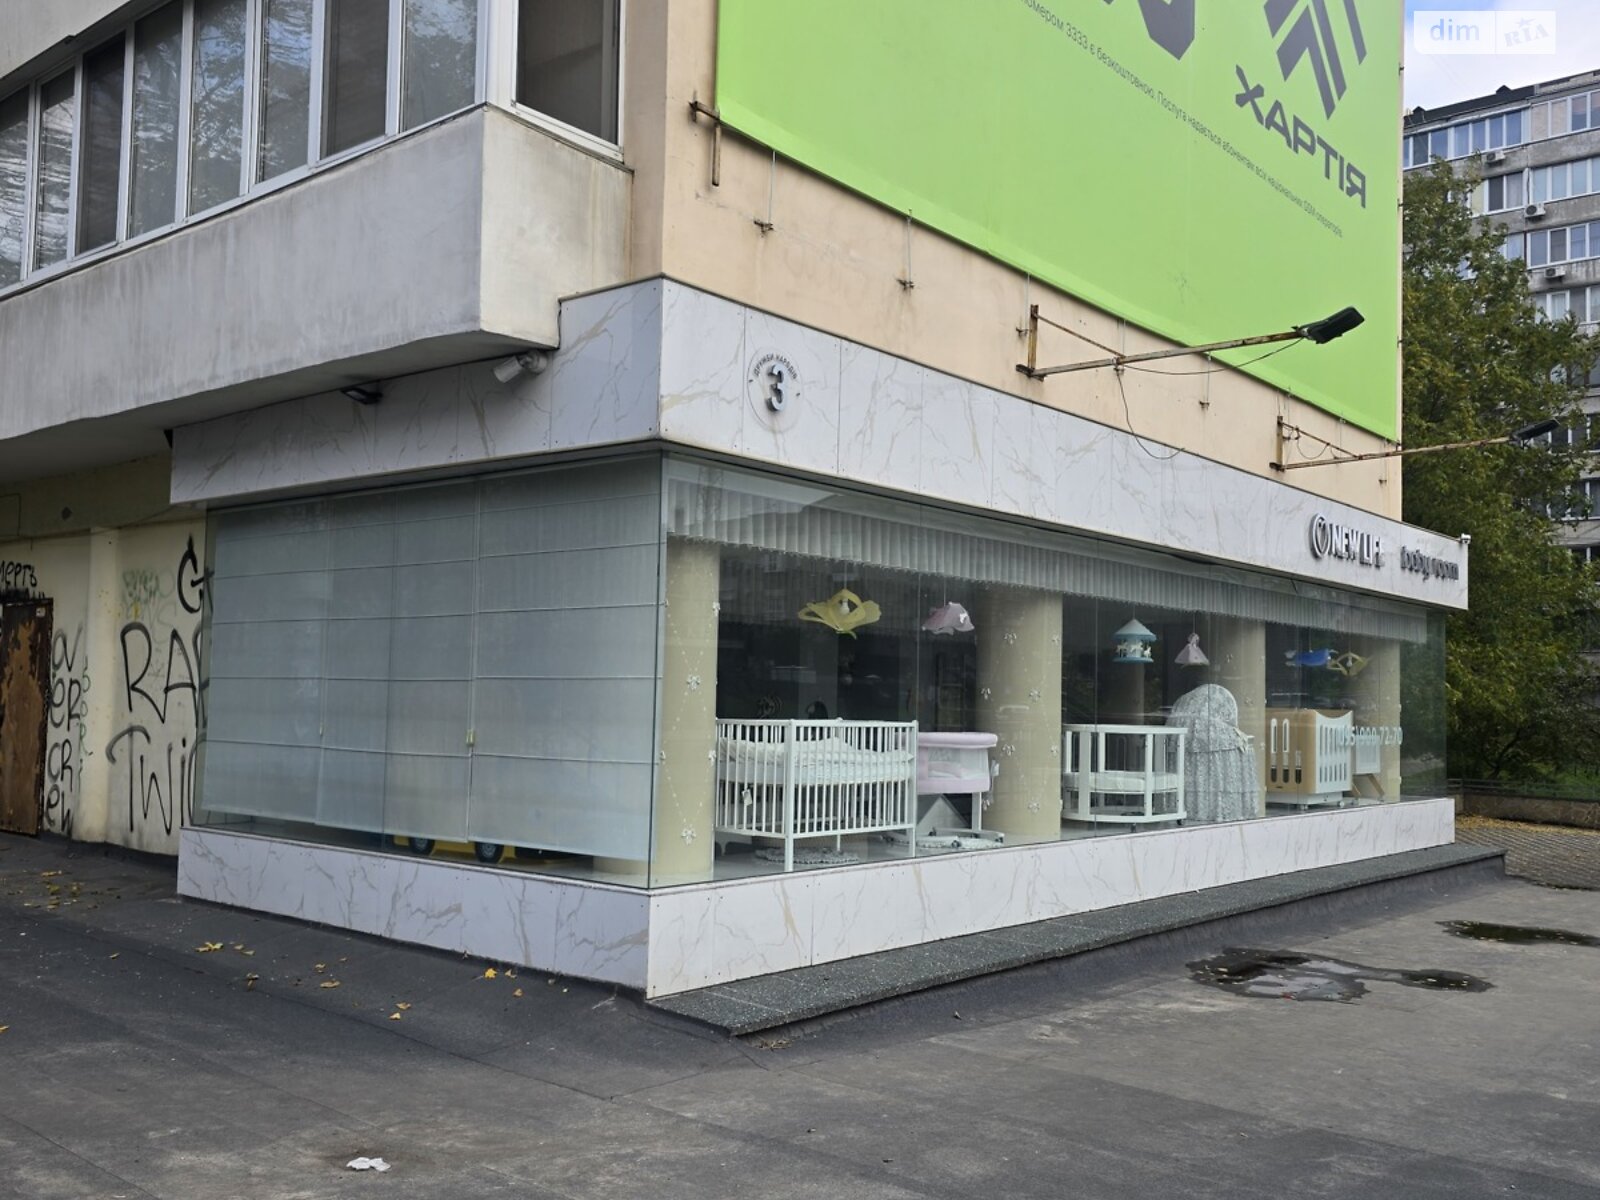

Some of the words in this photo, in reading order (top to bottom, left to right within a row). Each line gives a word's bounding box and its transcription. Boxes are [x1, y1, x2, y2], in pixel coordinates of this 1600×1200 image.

[1022, 0, 1064, 30] омером
[1066, 22, 1088, 49] 3333
[1157, 90, 1186, 121] Послуга
[1236, 64, 1366, 209] ХАРТІЯ
[765, 363, 787, 412] 3
